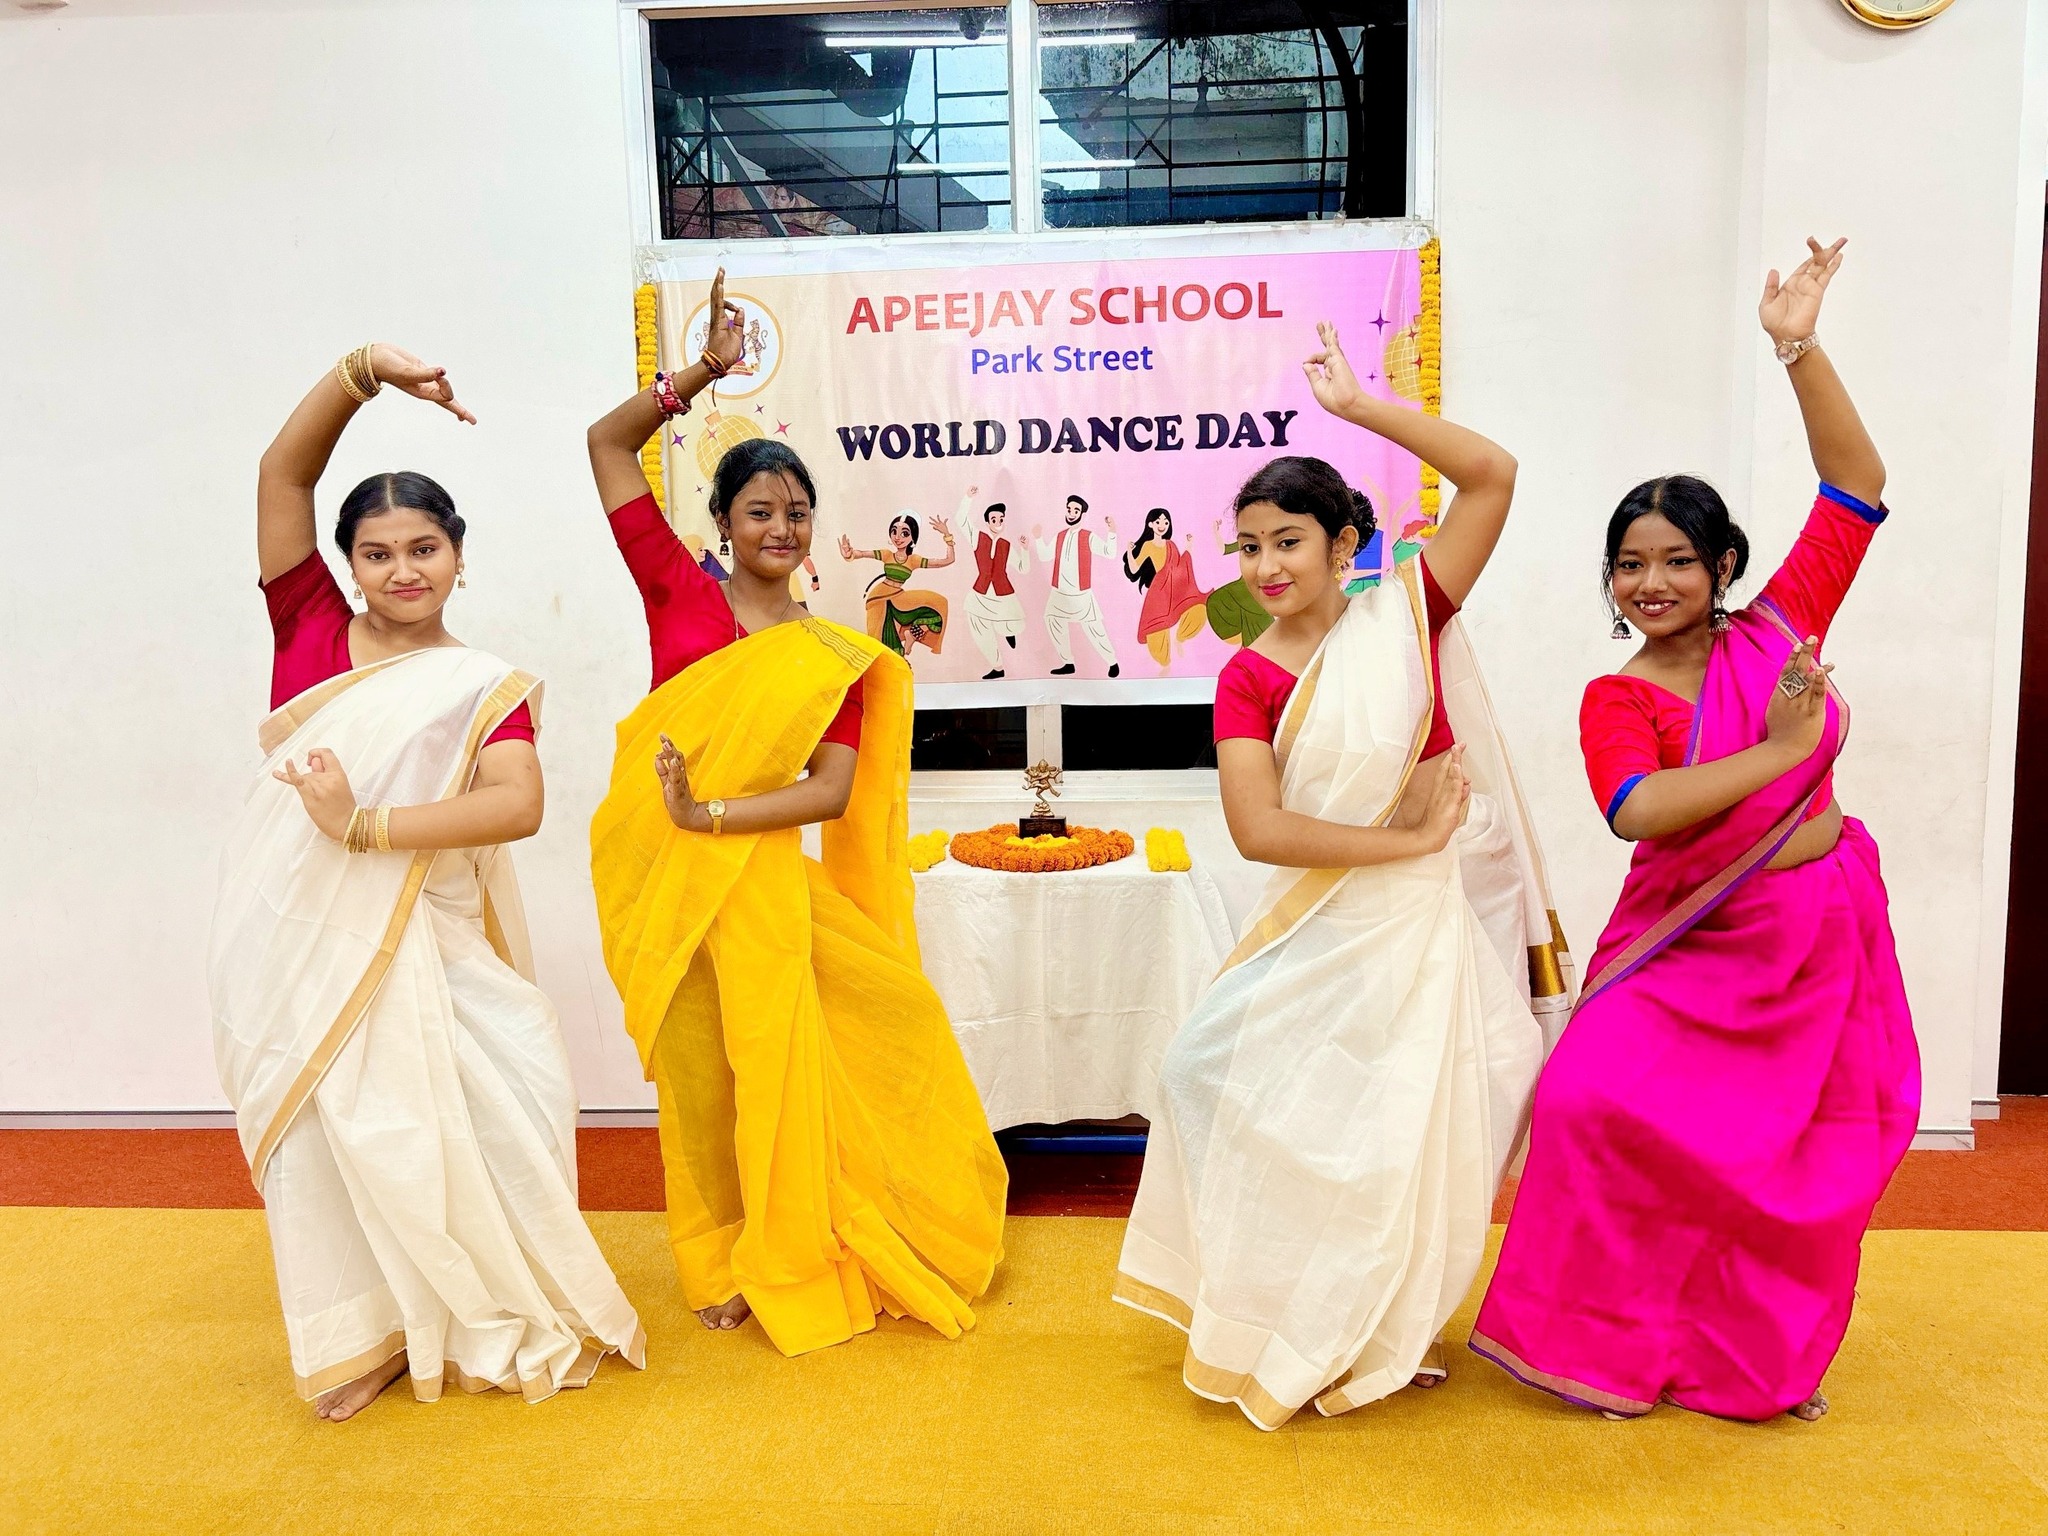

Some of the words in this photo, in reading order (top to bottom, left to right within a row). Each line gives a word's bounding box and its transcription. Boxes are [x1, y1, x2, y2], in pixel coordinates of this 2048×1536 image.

[846, 288, 1055, 338] APEEJAY
[1069, 281, 1284, 326] SCHOOL
[971, 345, 1043, 375] Park
[1053, 345, 1154, 372] Street
[835, 419, 1006, 462] WORLD
[1018, 414, 1184, 454] DANCE
[1194, 409, 1299, 450] DAY
